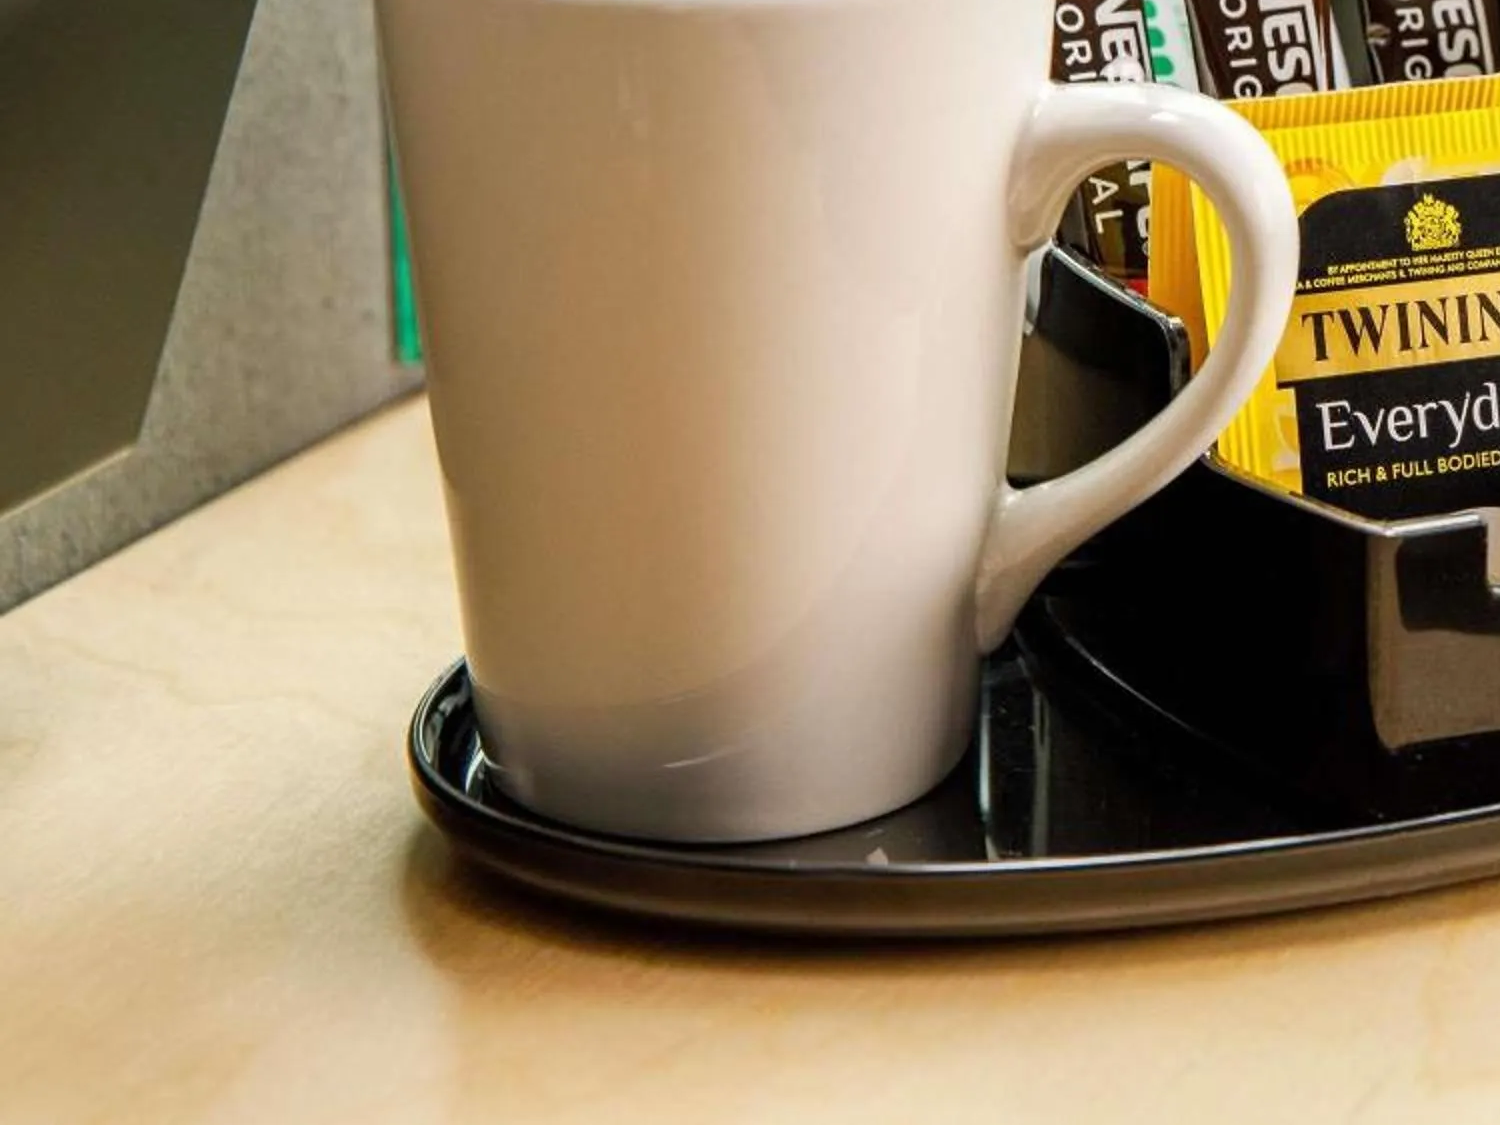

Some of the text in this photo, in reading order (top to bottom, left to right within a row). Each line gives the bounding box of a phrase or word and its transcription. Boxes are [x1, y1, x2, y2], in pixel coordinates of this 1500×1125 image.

[1400, 257, 1411, 266] TO
[1347, 271, 1397, 284] MERCHANTS
[1408, 265, 1444, 276] TWINING
[1447, 262, 1464, 272] AND
[1327, 468, 1371, 489] RICH
[1376, 464, 1388, 481] &
[1393, 459, 1434, 480] FULL
